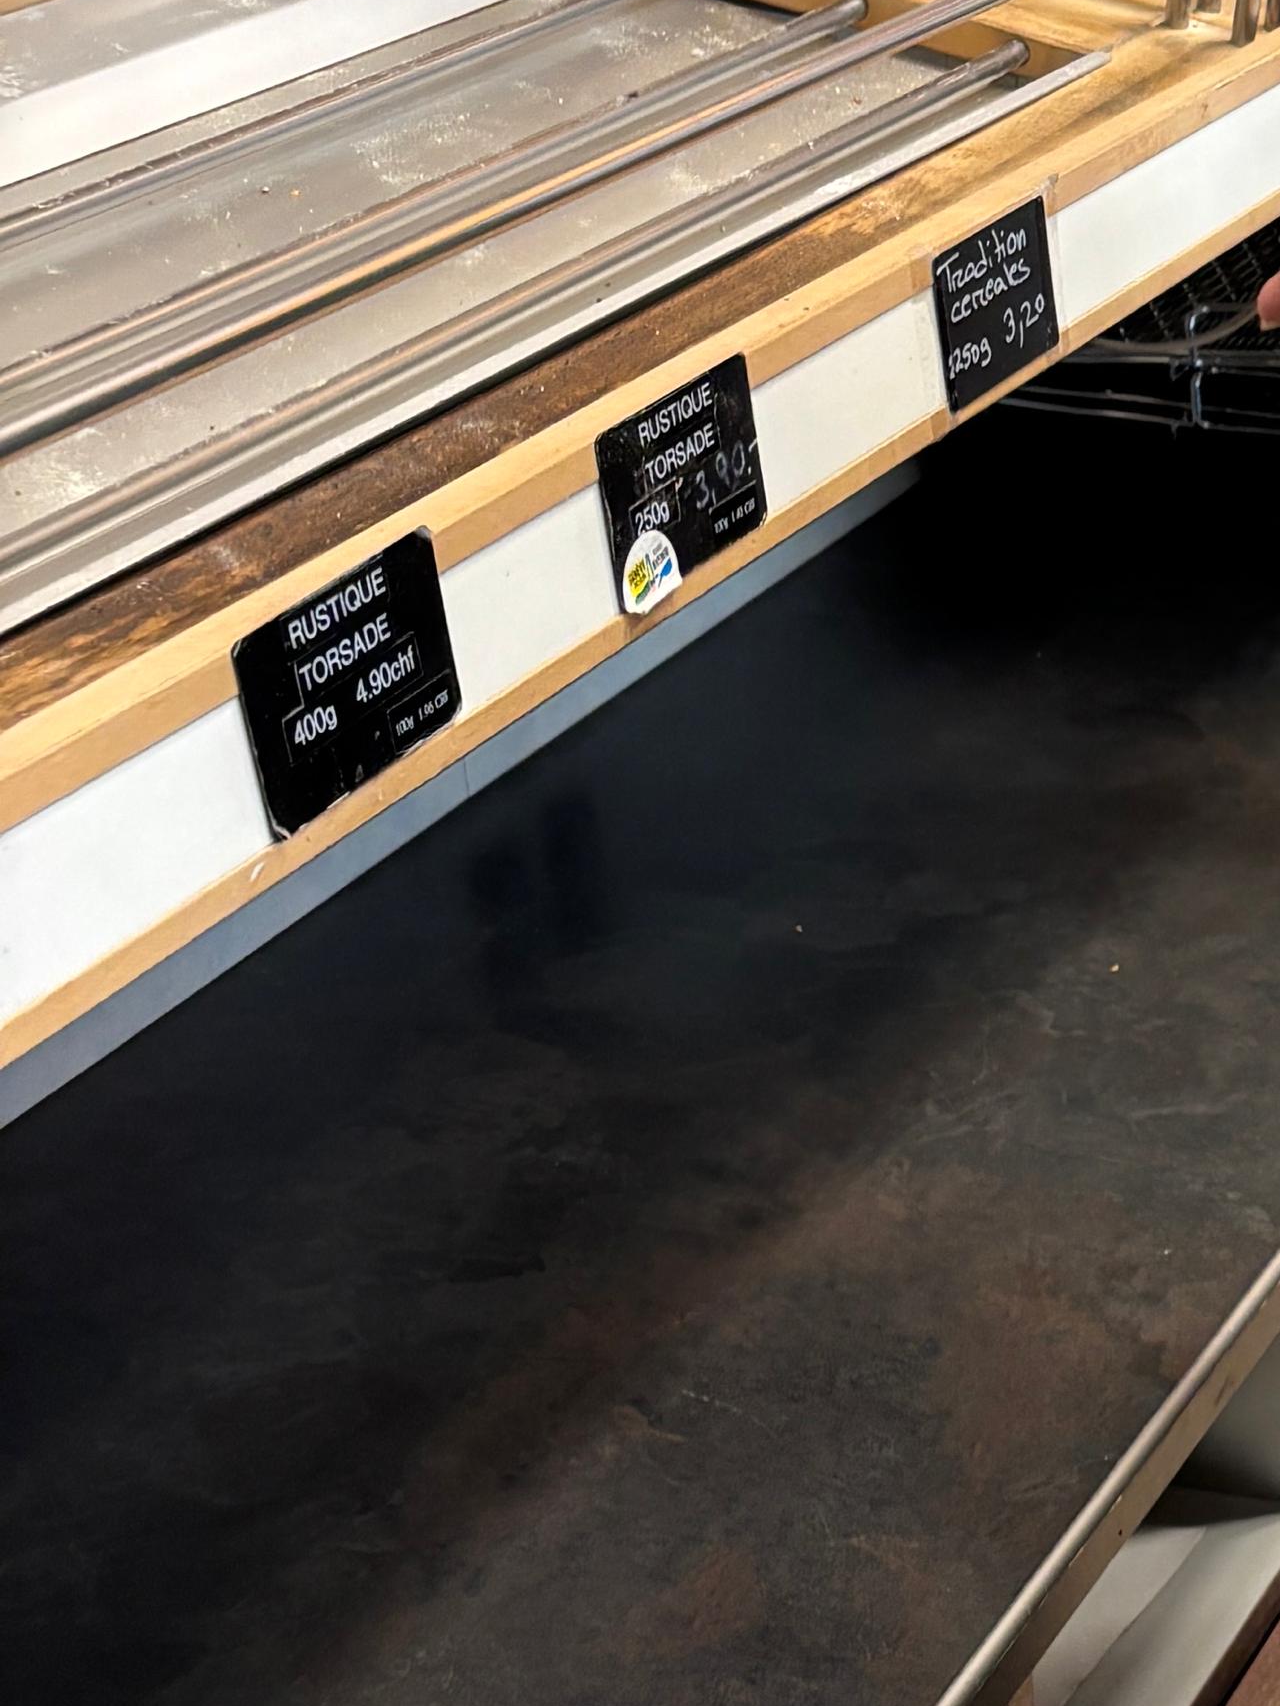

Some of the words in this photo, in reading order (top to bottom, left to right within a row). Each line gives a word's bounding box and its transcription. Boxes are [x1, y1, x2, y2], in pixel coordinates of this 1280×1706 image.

[936, 228, 1027, 293] Tradition
[1002, 293, 1045, 349] 3,20
[638, 381, 713, 445] RUSTIQUE
[645, 422, 716, 486] TORSADE
[634, 500, 671, 537] 250g
[288, 565, 387, 649] RUSTIQUE
[299, 612, 392, 692] TORSADE
[293, 705, 339, 746] 400g
[355, 644, 417, 704] 4.90chf
